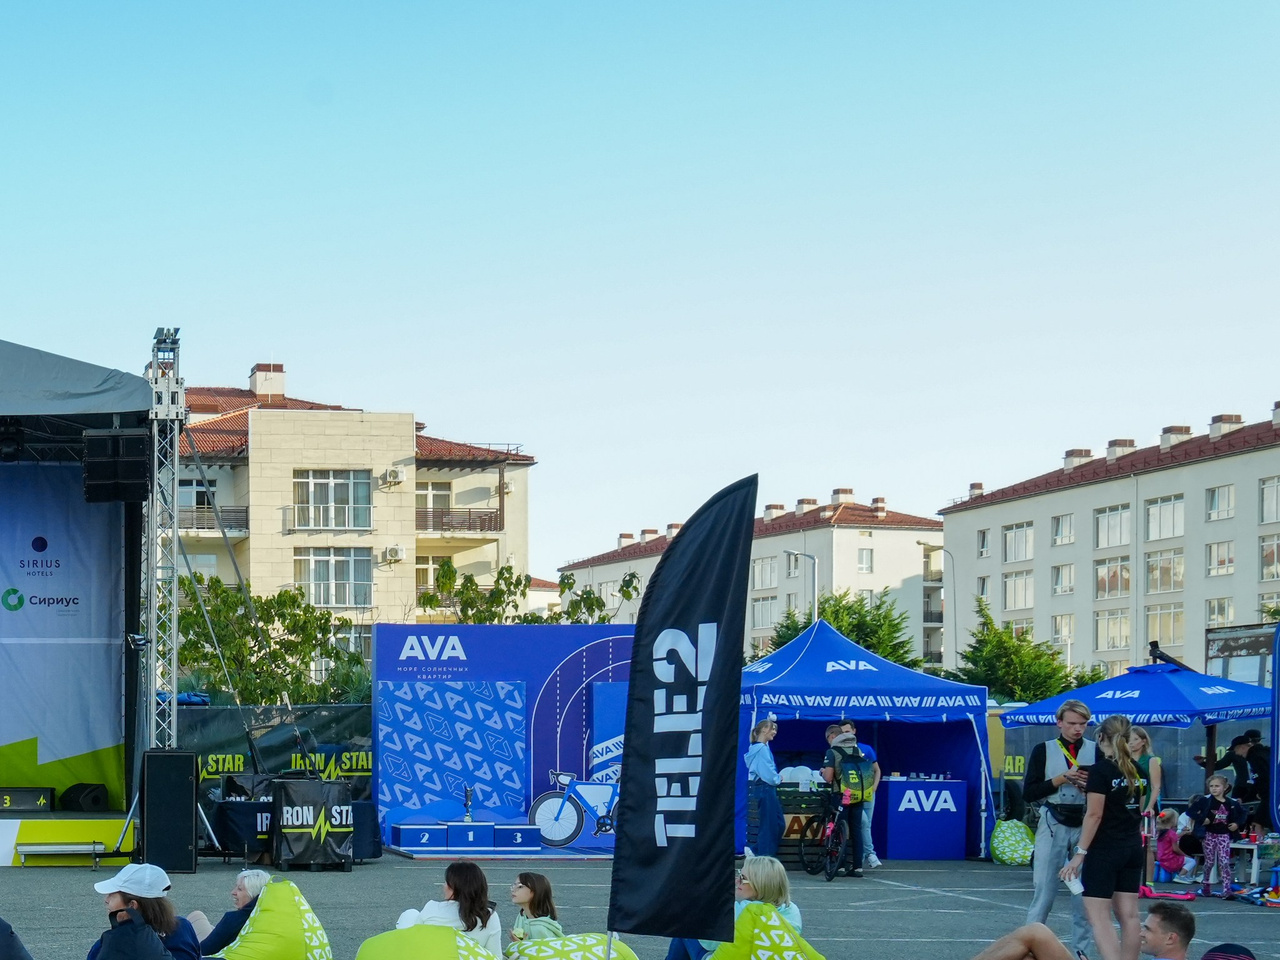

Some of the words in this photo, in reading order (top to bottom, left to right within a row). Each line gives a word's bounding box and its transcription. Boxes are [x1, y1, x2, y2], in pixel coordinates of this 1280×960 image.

[19, 559, 61, 568] SIRIUS
[29, 595, 79, 607] Сириус
[399, 635, 467, 660] AVA
[826, 660, 879, 672] AVA
[1095, 690, 1141, 699] AVA
[1199, 685, 1236, 695] AVA
[761, 694, 788, 706] AVA
[848, 695, 878, 707] AVA
[937, 696, 966, 707] AVA
[1150, 714, 1176, 723] AVA
[653, 622, 718, 847] TELE2
[207, 754, 244, 772] STAR
[1004, 756, 1025, 773] AR
[3, 795, 11, 807] 3
[898, 790, 957, 812] AVA
[419, 832, 429, 843] 2
[467, 831, 474, 841] 1
[513, 832, 523, 843] 3
